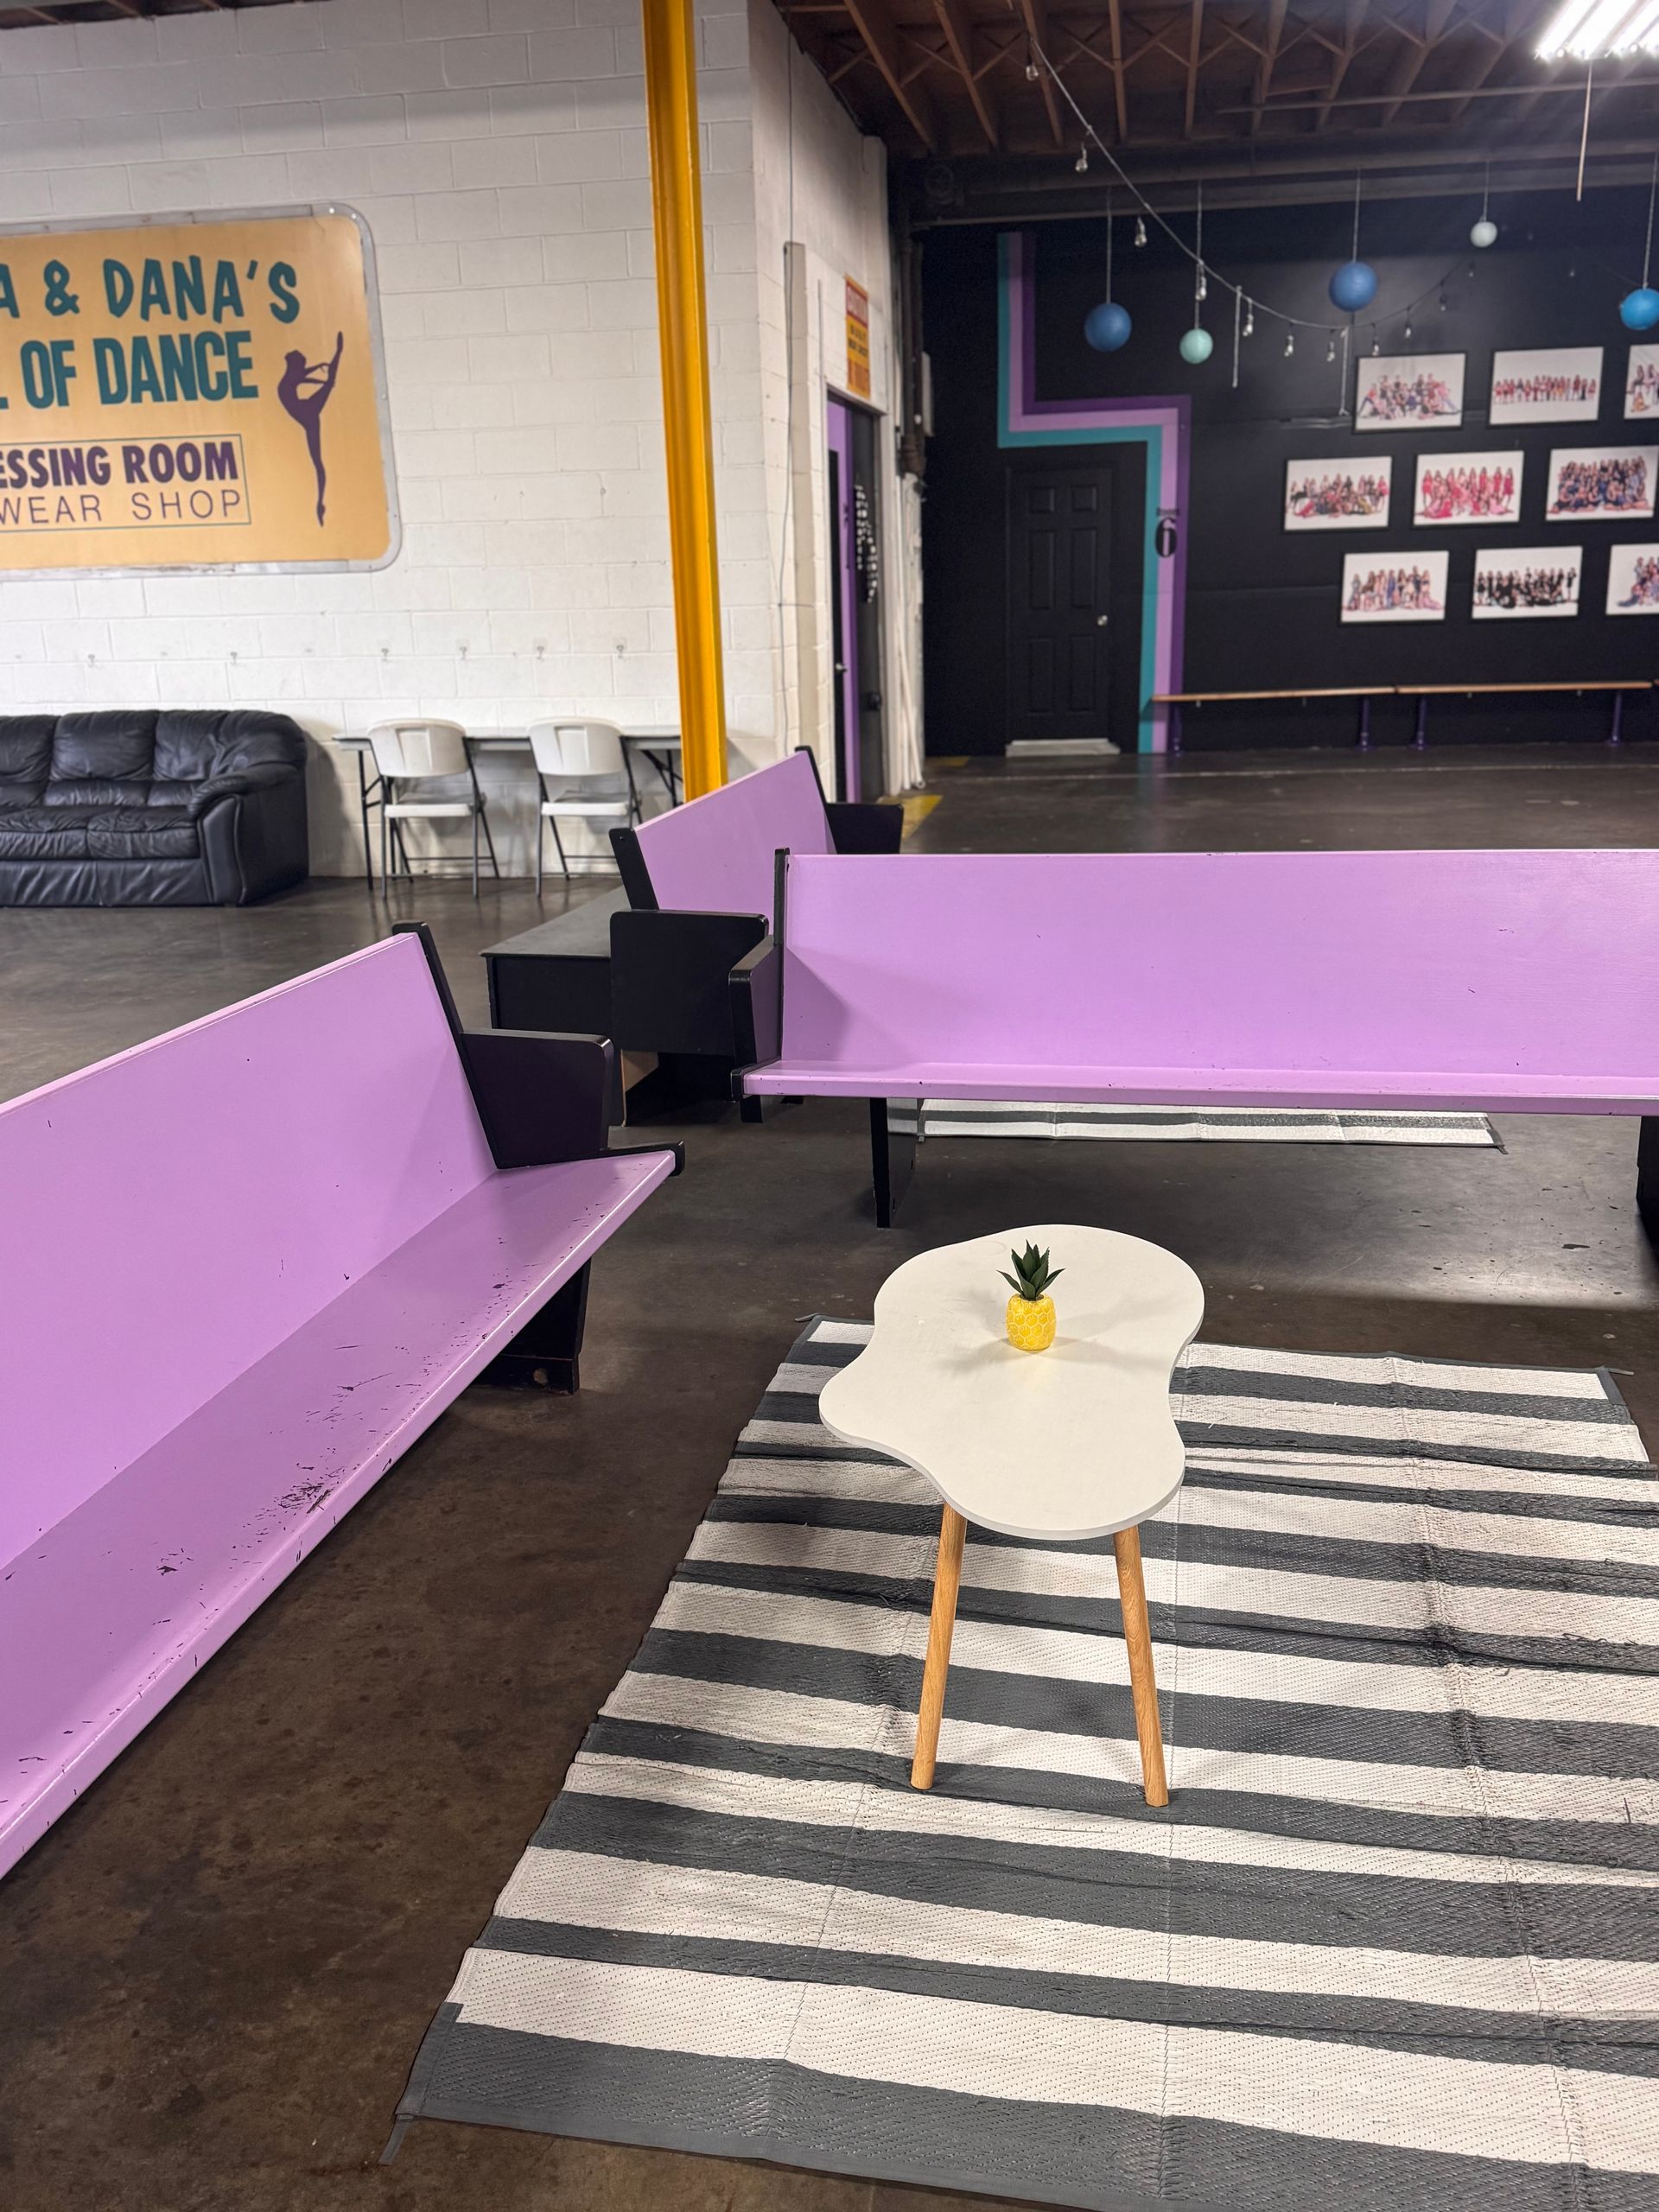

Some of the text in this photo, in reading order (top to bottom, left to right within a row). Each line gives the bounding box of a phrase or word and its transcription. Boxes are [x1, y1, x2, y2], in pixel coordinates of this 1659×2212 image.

[43, 259, 79, 316] &
[103, 255, 300, 324] DANA'S
[20, 331, 258, 409] OF DANCE
[122, 442, 238, 484] ROOM
[131, 489, 240, 520] SHOP
[1155, 517, 1178, 558] 6
